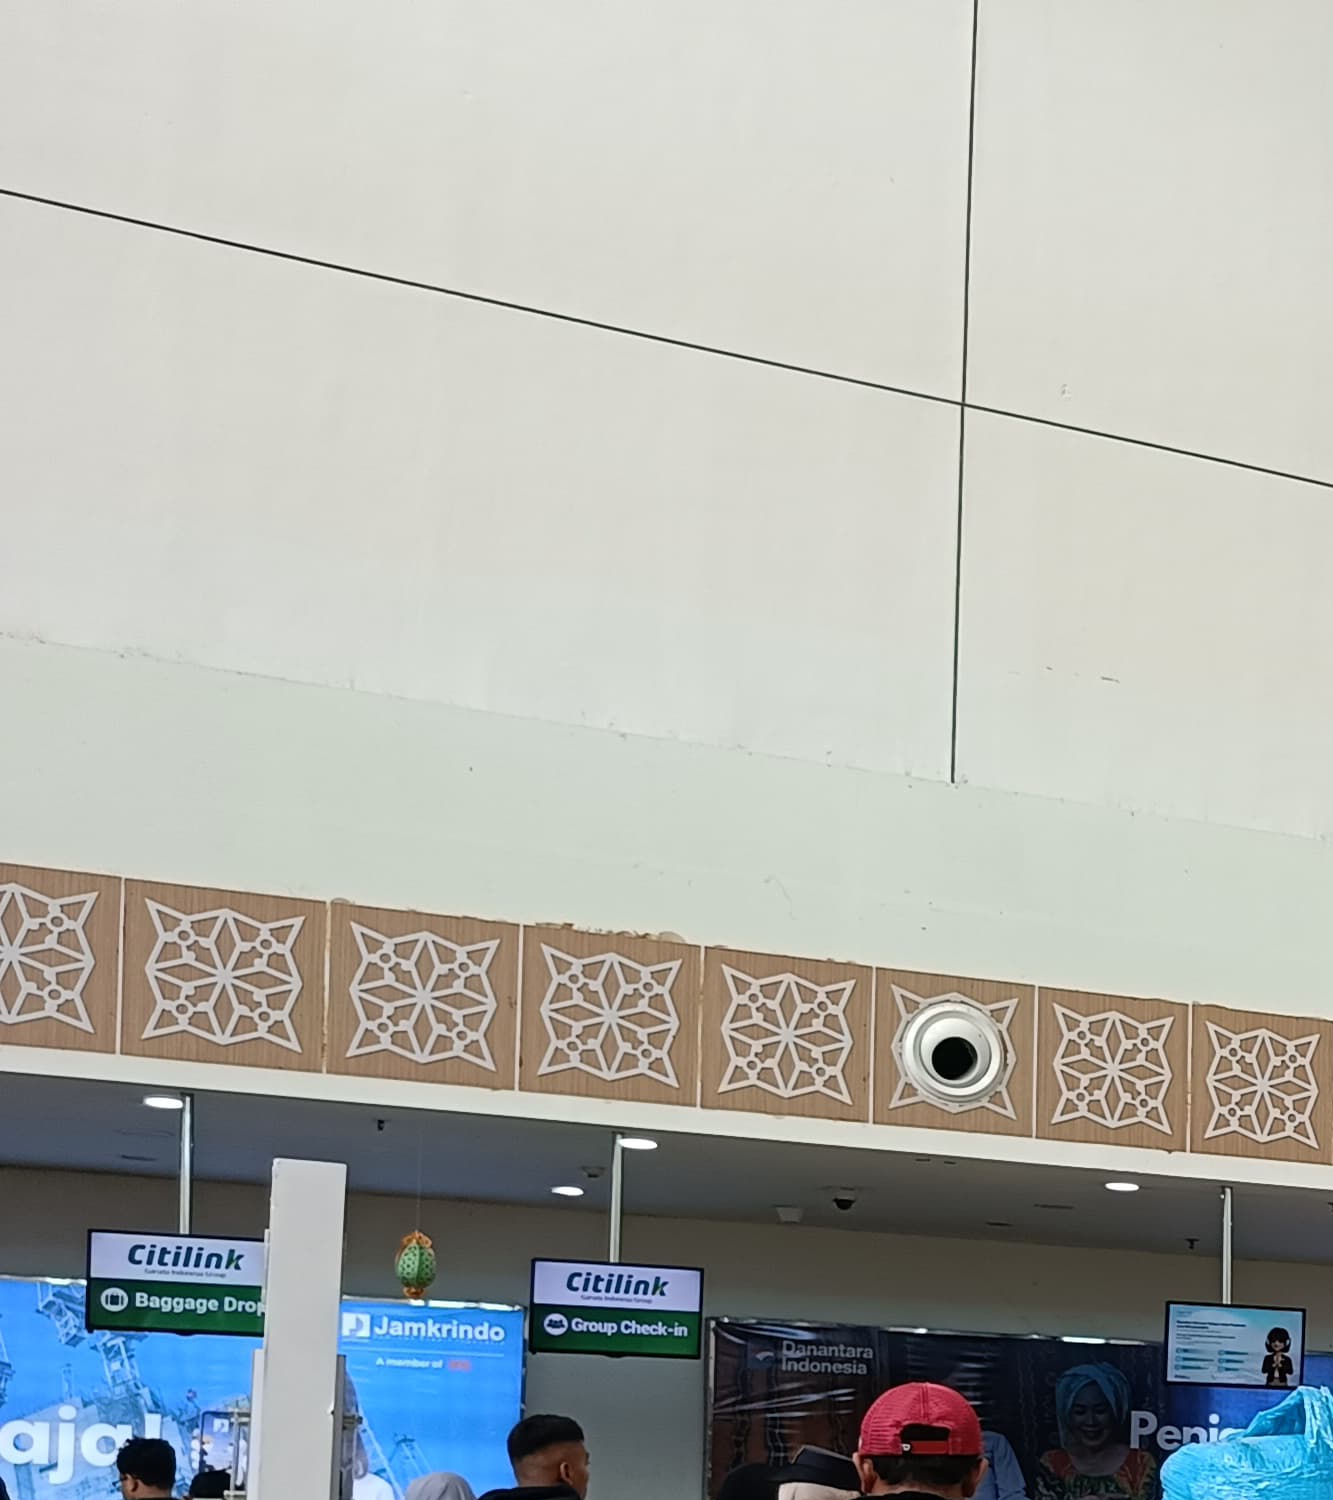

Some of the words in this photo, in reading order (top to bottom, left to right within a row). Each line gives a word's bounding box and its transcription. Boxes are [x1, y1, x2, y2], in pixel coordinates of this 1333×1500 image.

[128, 1244, 245, 1270] Citilink
[566, 1272, 669, 1296] Citilink
[135, 1292, 219, 1314] Baggage
[374, 1316, 505, 1341] Jamkrindo
[571, 1317, 617, 1336] Group
[620, 1320, 688, 1336] Check-in
[783, 1340, 873, 1358] Danantara
[782, 1356, 867, 1374] Indonesia
